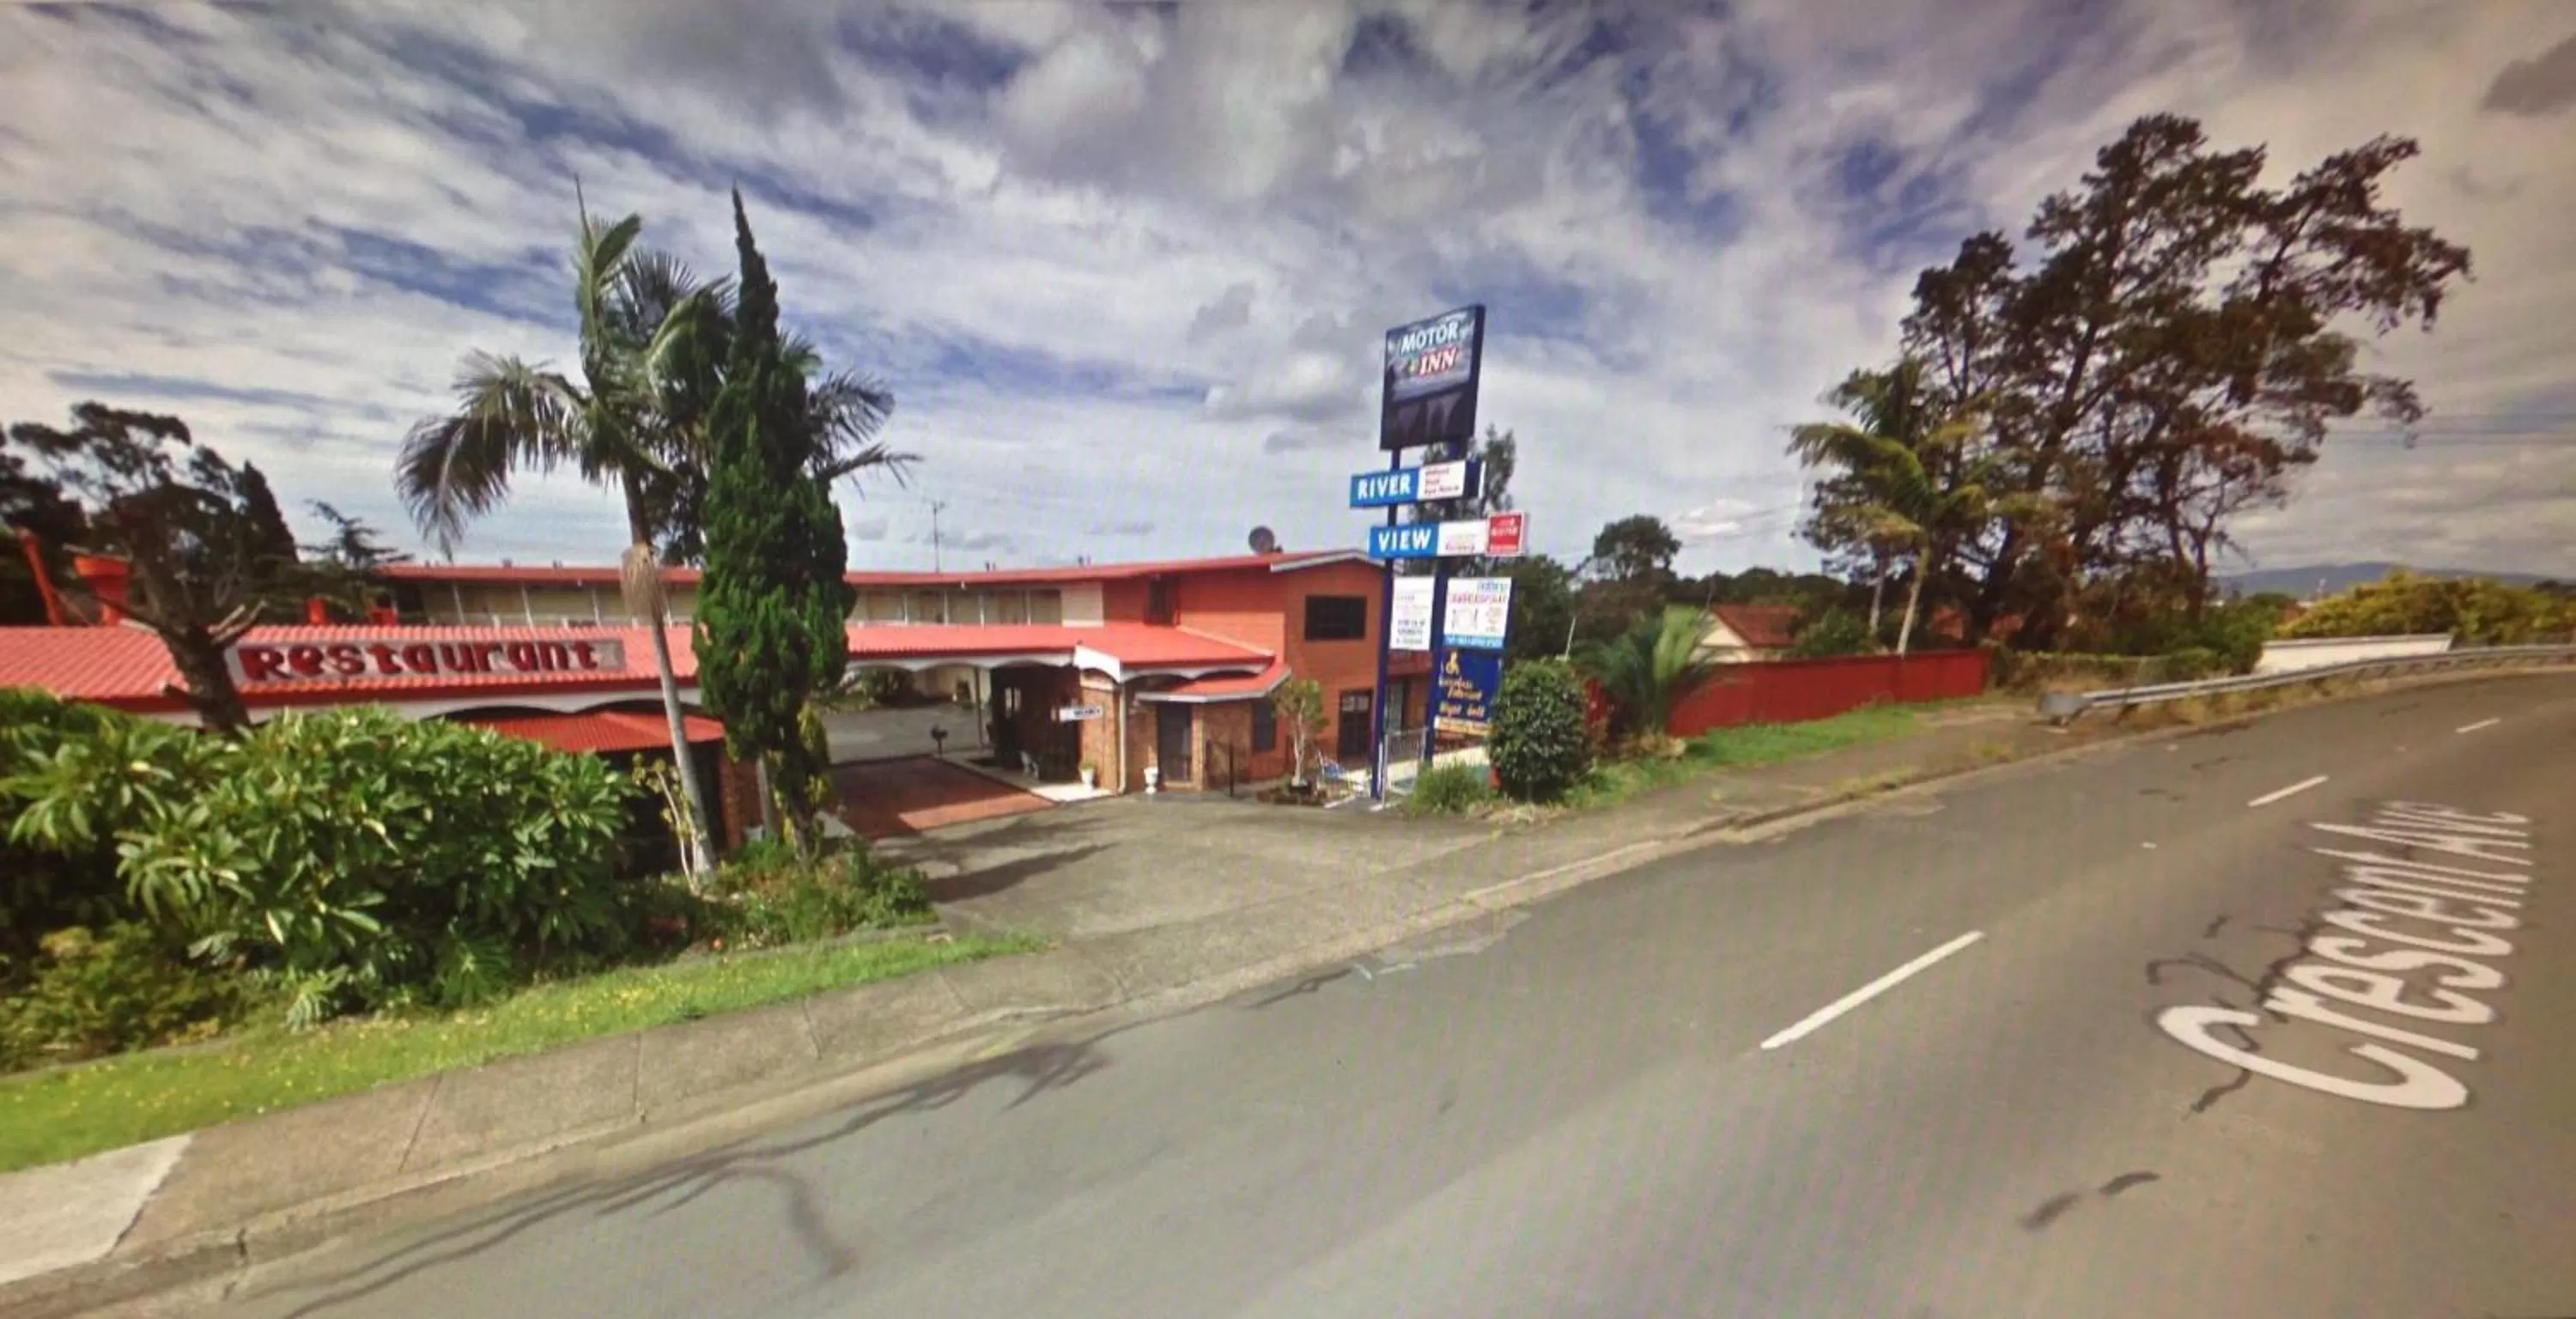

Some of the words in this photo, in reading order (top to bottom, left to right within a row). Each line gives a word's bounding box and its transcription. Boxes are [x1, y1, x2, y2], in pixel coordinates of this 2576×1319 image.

[1400, 320, 1459, 356] MOTOR
[1419, 346, 1458, 376] INN
[1358, 474, 1412, 500] RIVER
[1378, 528, 1432, 551] VIEW
[238, 639, 599, 682] Restaurant
[2308, 800, 2534, 866] Ave
[2156, 847, 2534, 1110] Crescent
